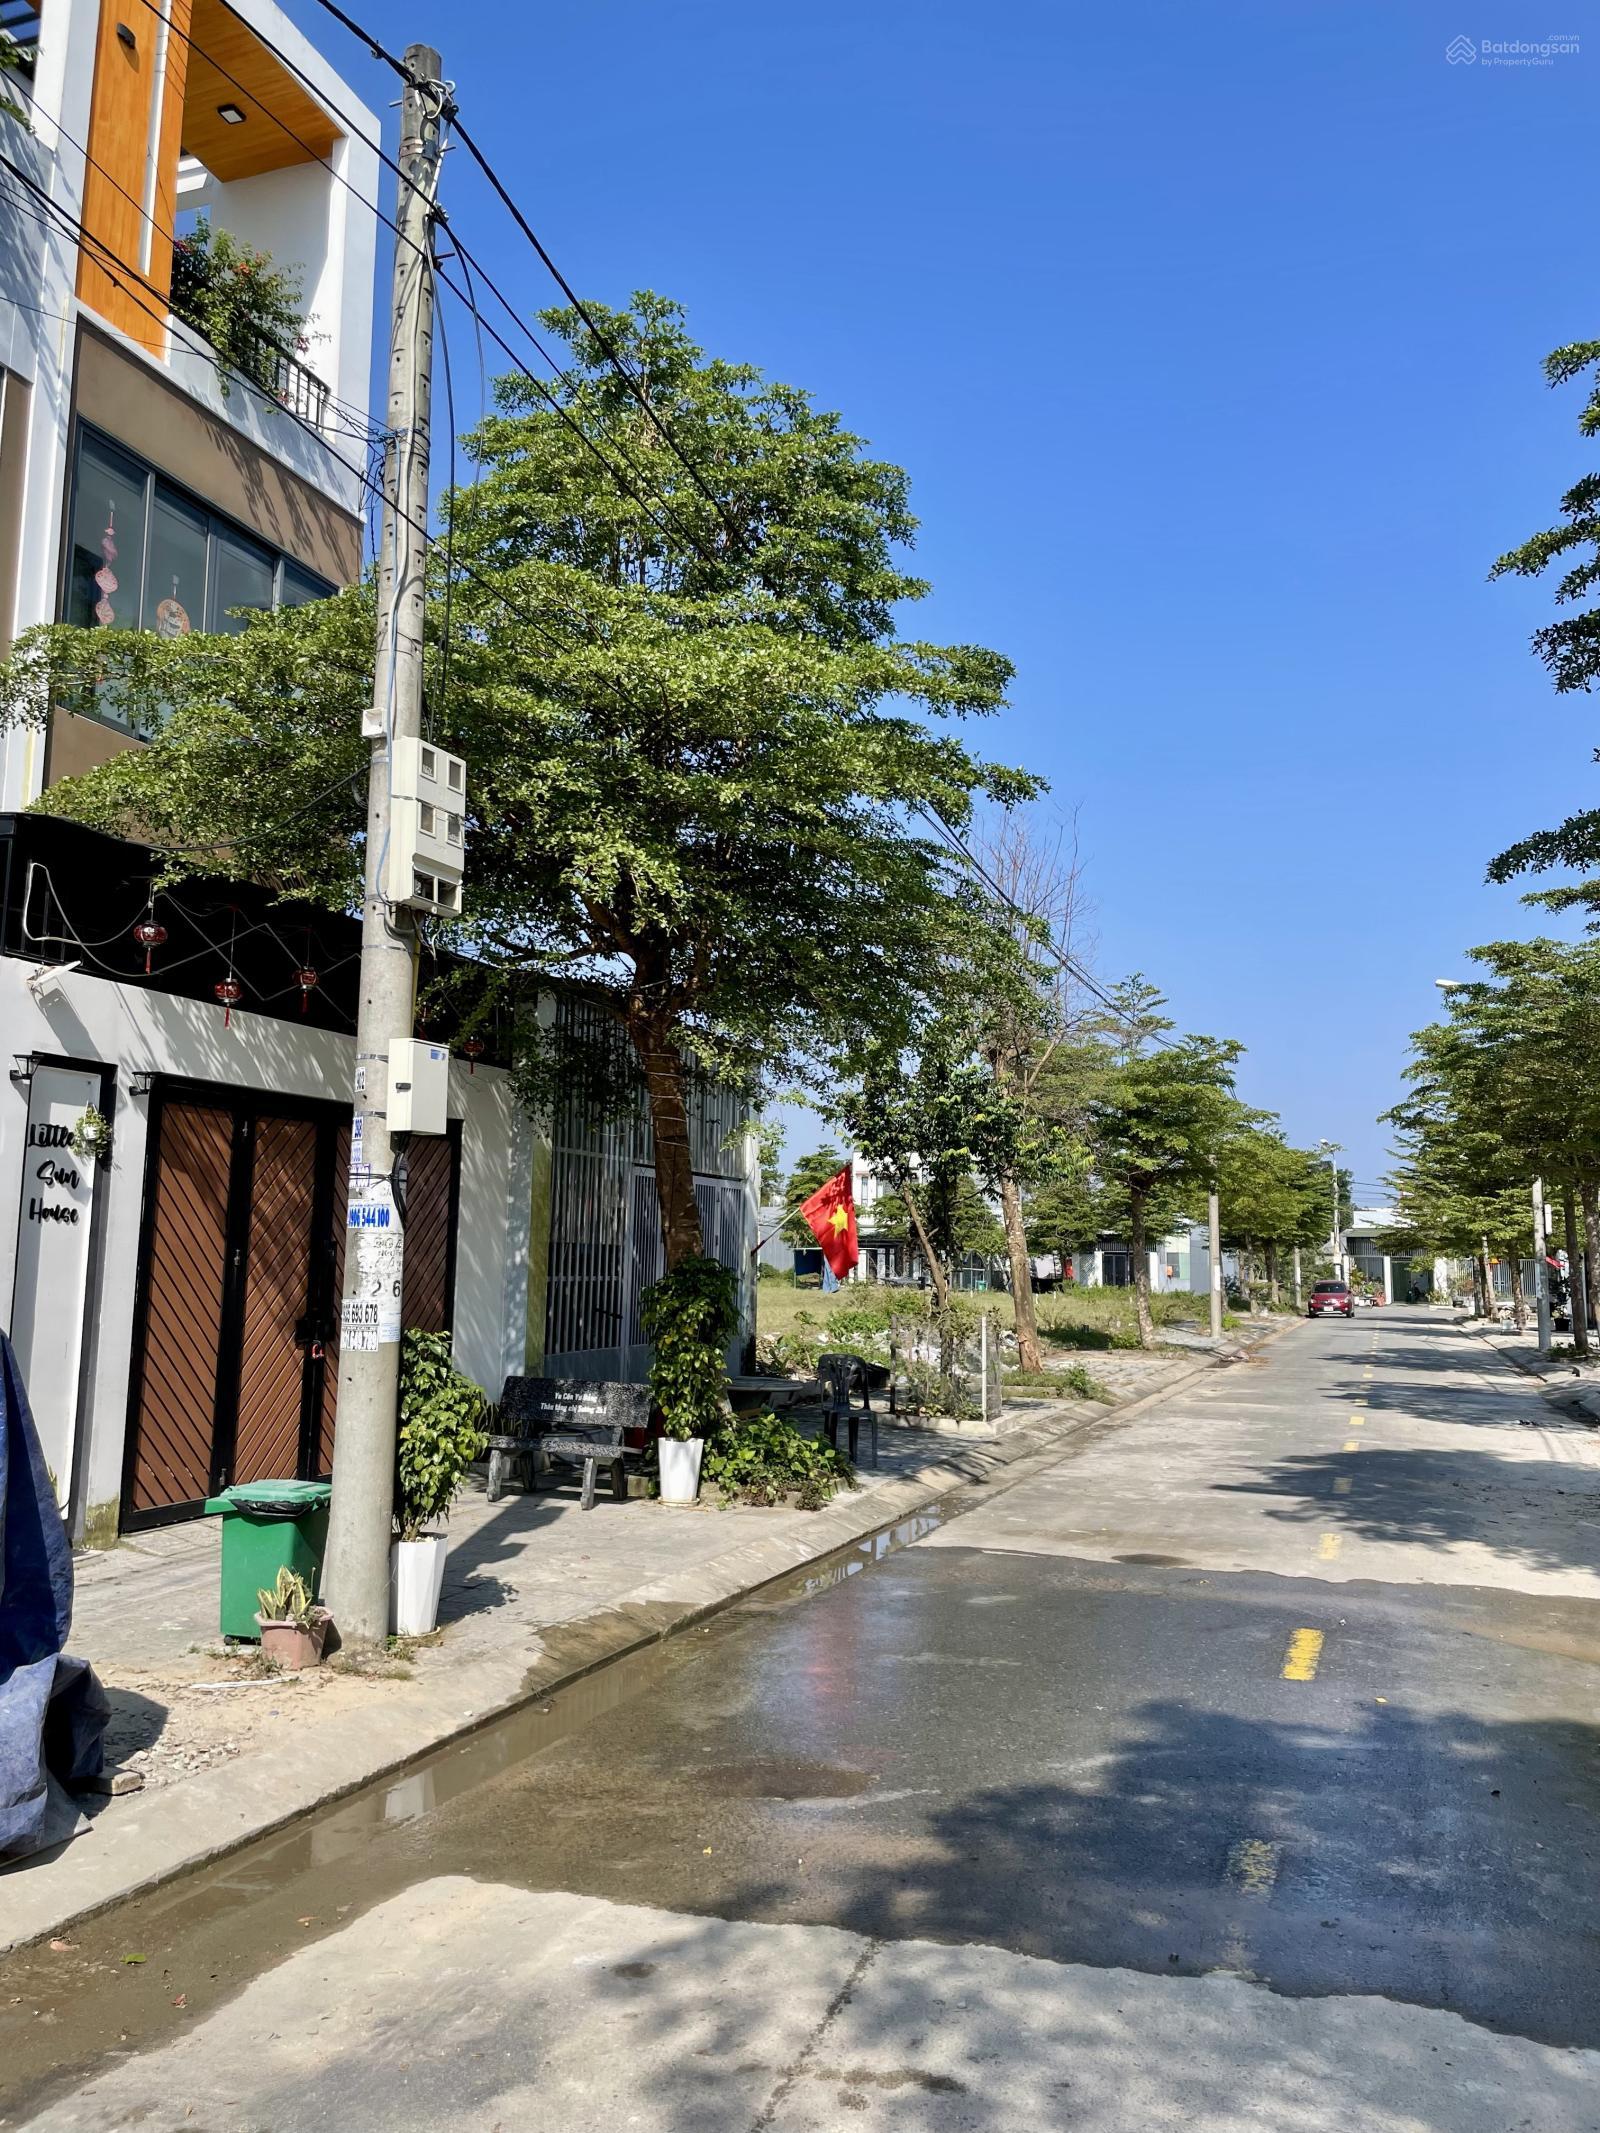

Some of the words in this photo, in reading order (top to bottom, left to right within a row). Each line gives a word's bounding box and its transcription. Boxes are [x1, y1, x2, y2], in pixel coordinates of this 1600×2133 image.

[28, 1123, 76, 1148] Little
[36, 1159, 80, 1190] Sun
[29, 1197, 79, 1224] House
